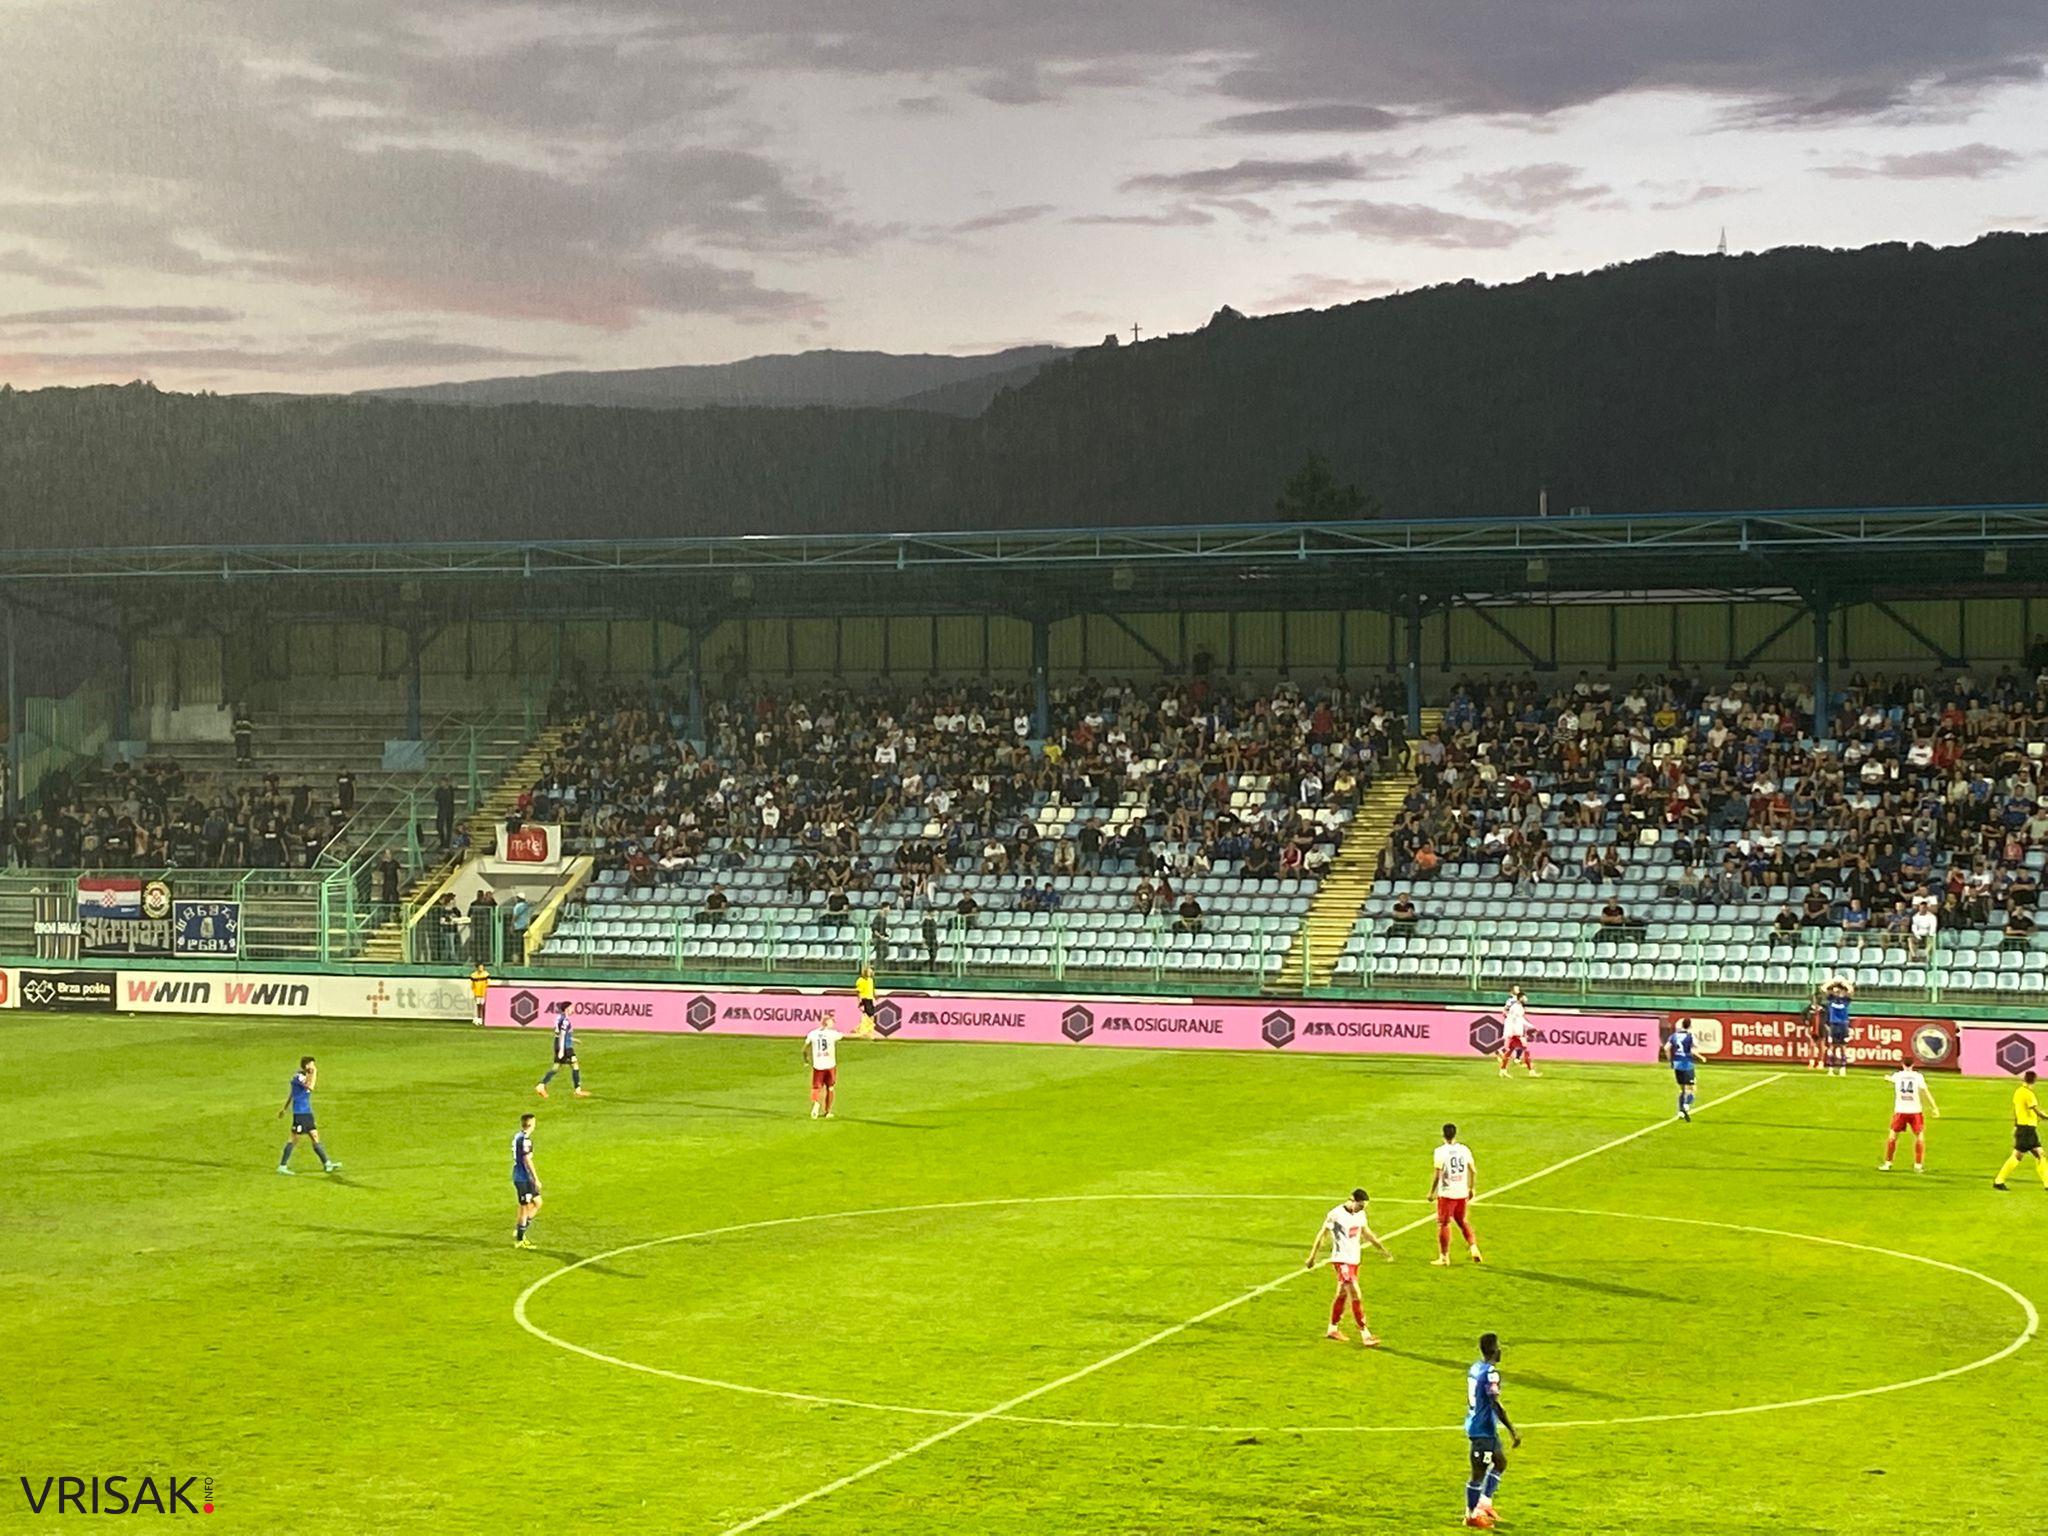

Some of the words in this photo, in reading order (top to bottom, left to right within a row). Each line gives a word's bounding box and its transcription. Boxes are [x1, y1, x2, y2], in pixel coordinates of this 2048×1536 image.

[575, 1002, 653, 1017] OSIGURANJE
[722, 1007, 751, 1019] ASA
[908, 1011, 939, 1024] ASA
[940, 1011, 1026, 1027] OSIGURANJE
[1101, 1017, 1133, 1031] ASA
[1134, 1017, 1223, 1033] OSIGURANJE
[1302, 1022, 1336, 1036] ASA
[1337, 1022, 1430, 1039] OSIGURANJE
[1549, 1029, 1648, 1047] OSIGURANJE
[1731, 1021, 1780, 1038] m:tel
[1867, 1024, 1902, 1045] liga
[1731, 1040, 1784, 1057] Bosne
